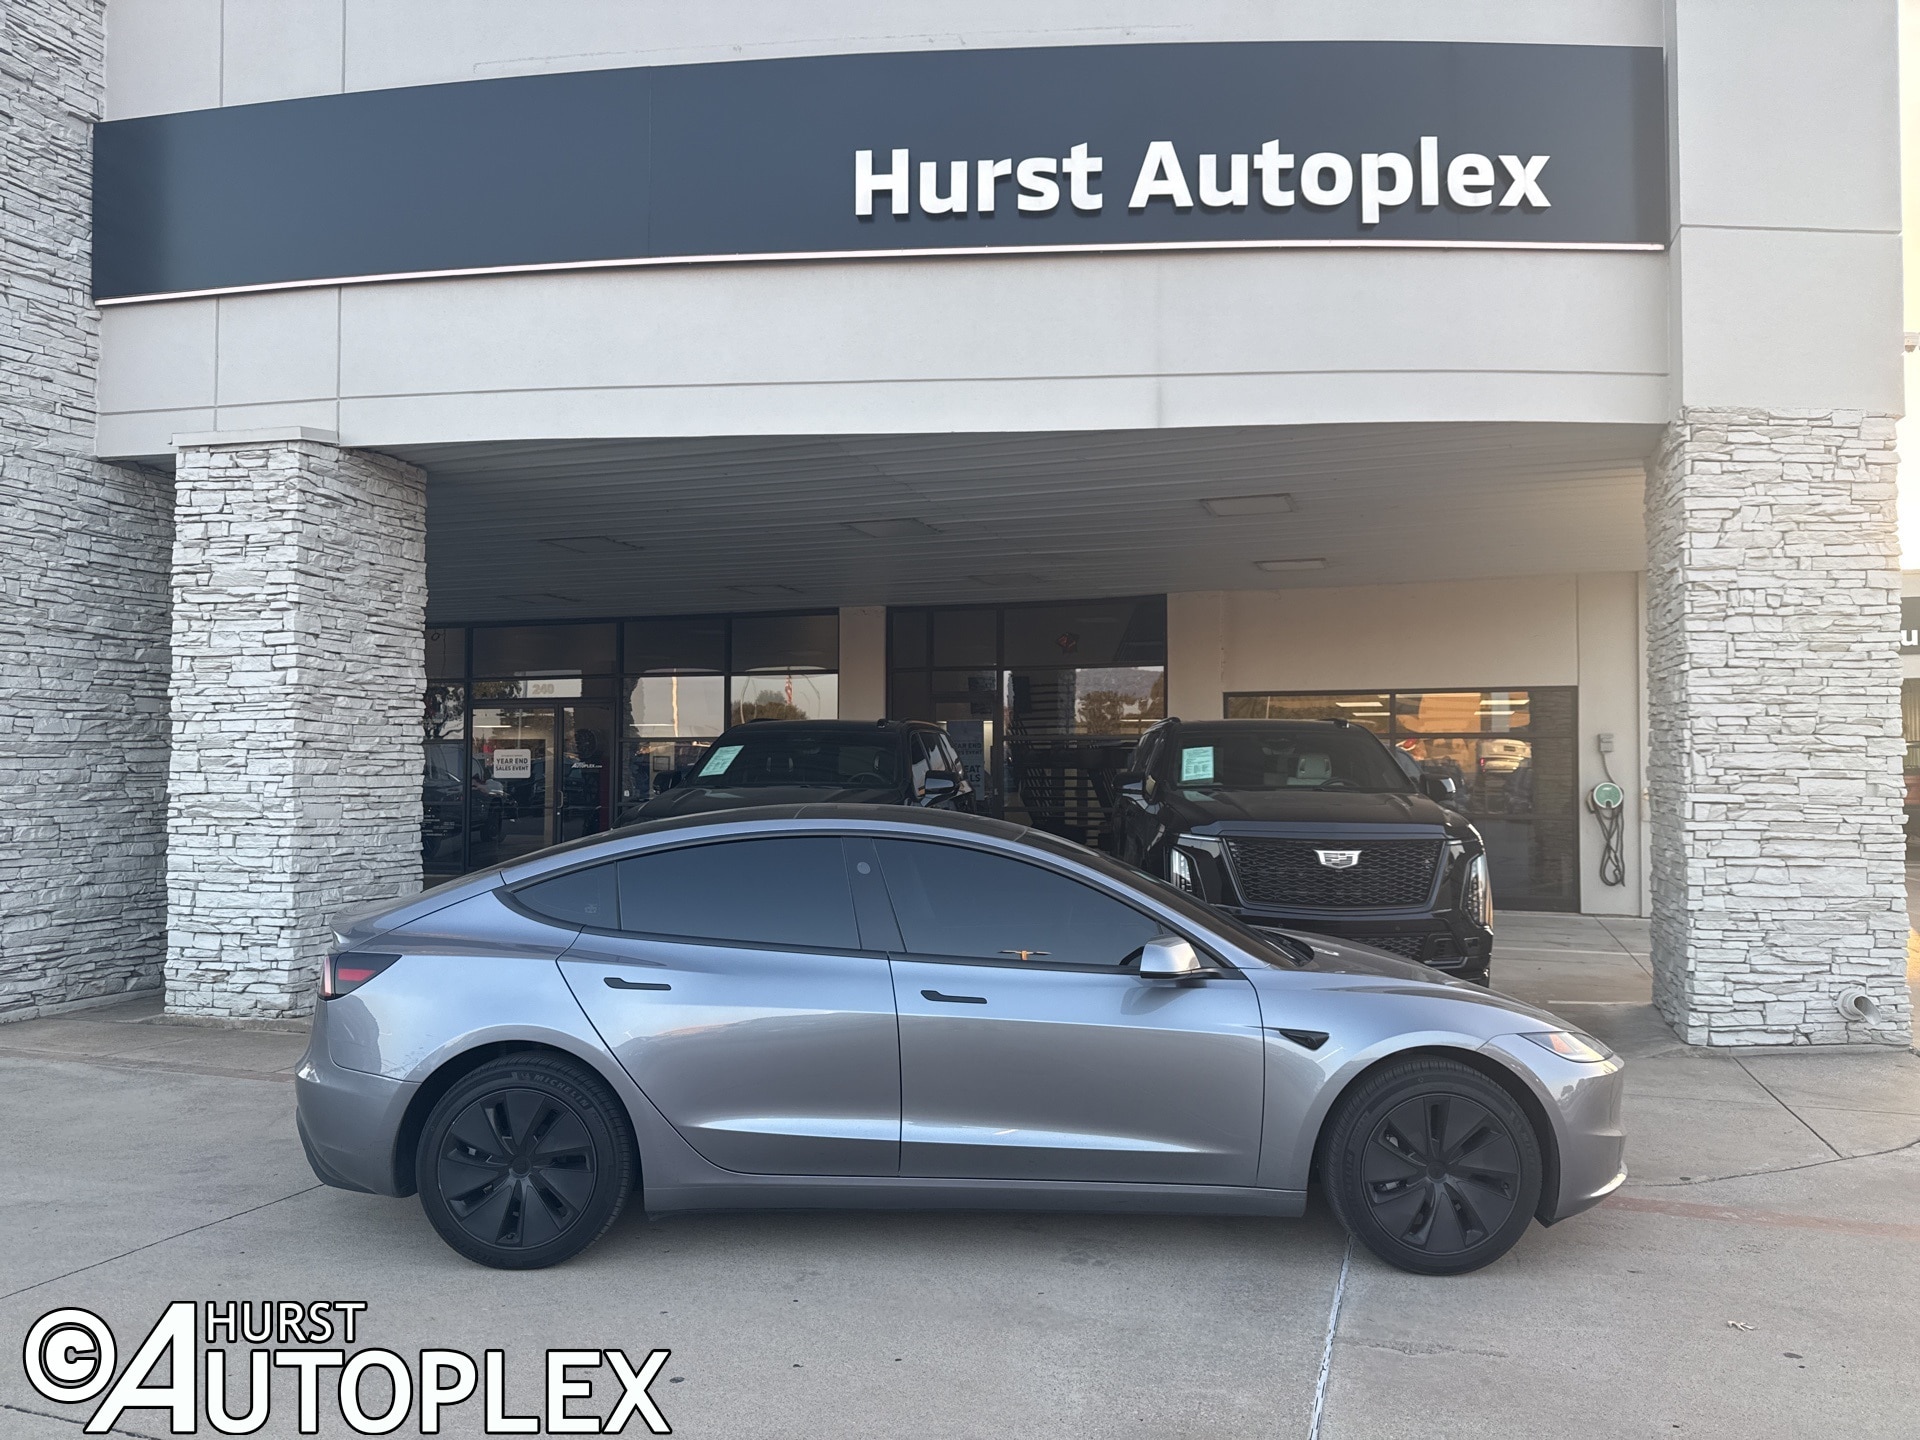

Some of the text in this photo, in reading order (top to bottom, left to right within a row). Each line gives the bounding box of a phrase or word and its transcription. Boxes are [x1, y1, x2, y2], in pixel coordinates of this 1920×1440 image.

[854, 136, 1551, 224] Hurst Autoplex
[532, 683, 555, 695] 240
[964, 765, 981, 773] EAT
[534, 1073, 589, 1108] MICHELIN
